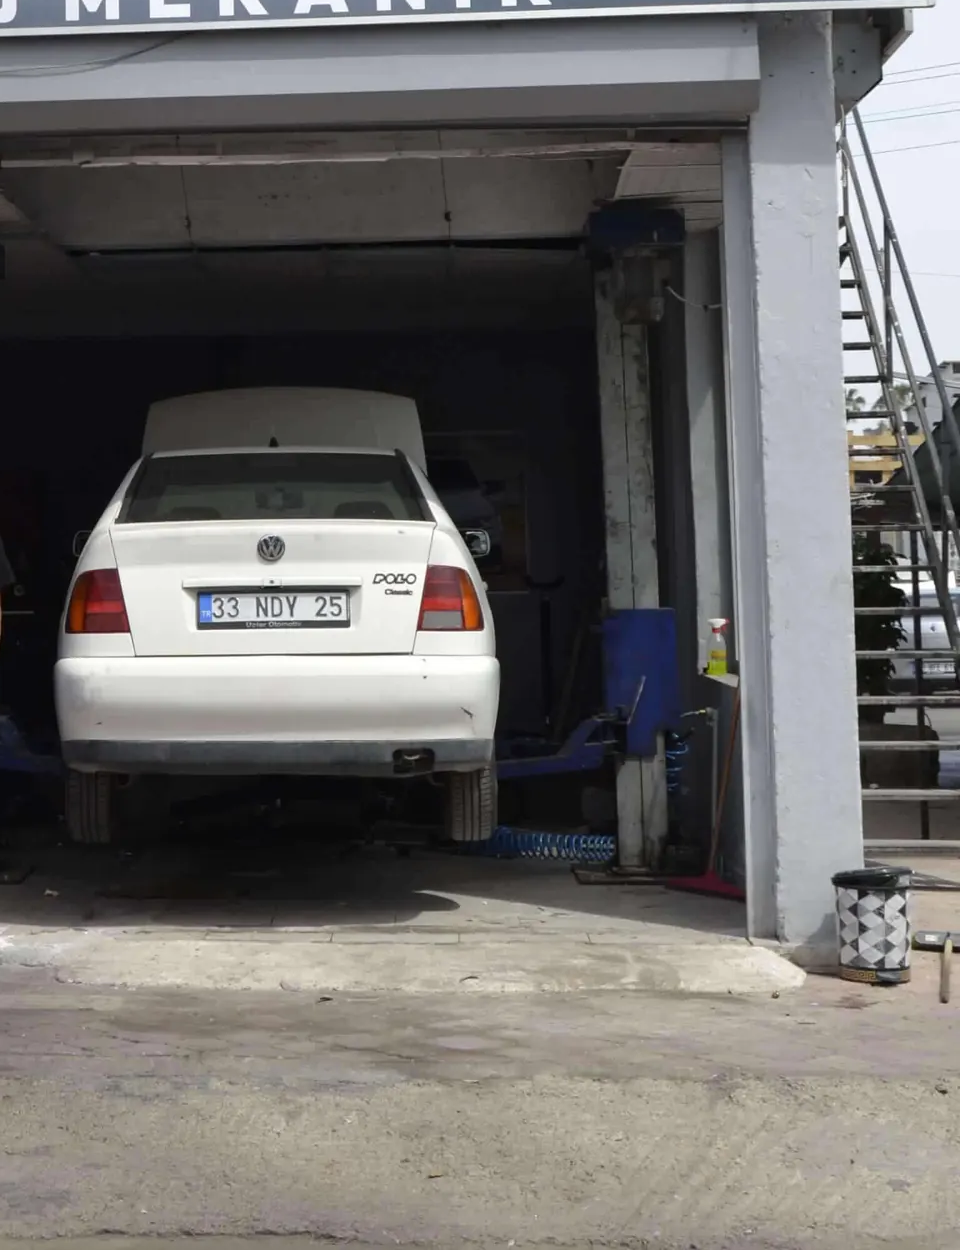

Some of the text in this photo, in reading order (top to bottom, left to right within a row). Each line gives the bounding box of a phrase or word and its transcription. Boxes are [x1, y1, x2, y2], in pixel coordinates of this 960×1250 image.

[372, 573, 417, 585] POLO
[212, 596, 240, 618] 33
[255, 595, 298, 618] NDY
[314, 596, 343, 617] 25
